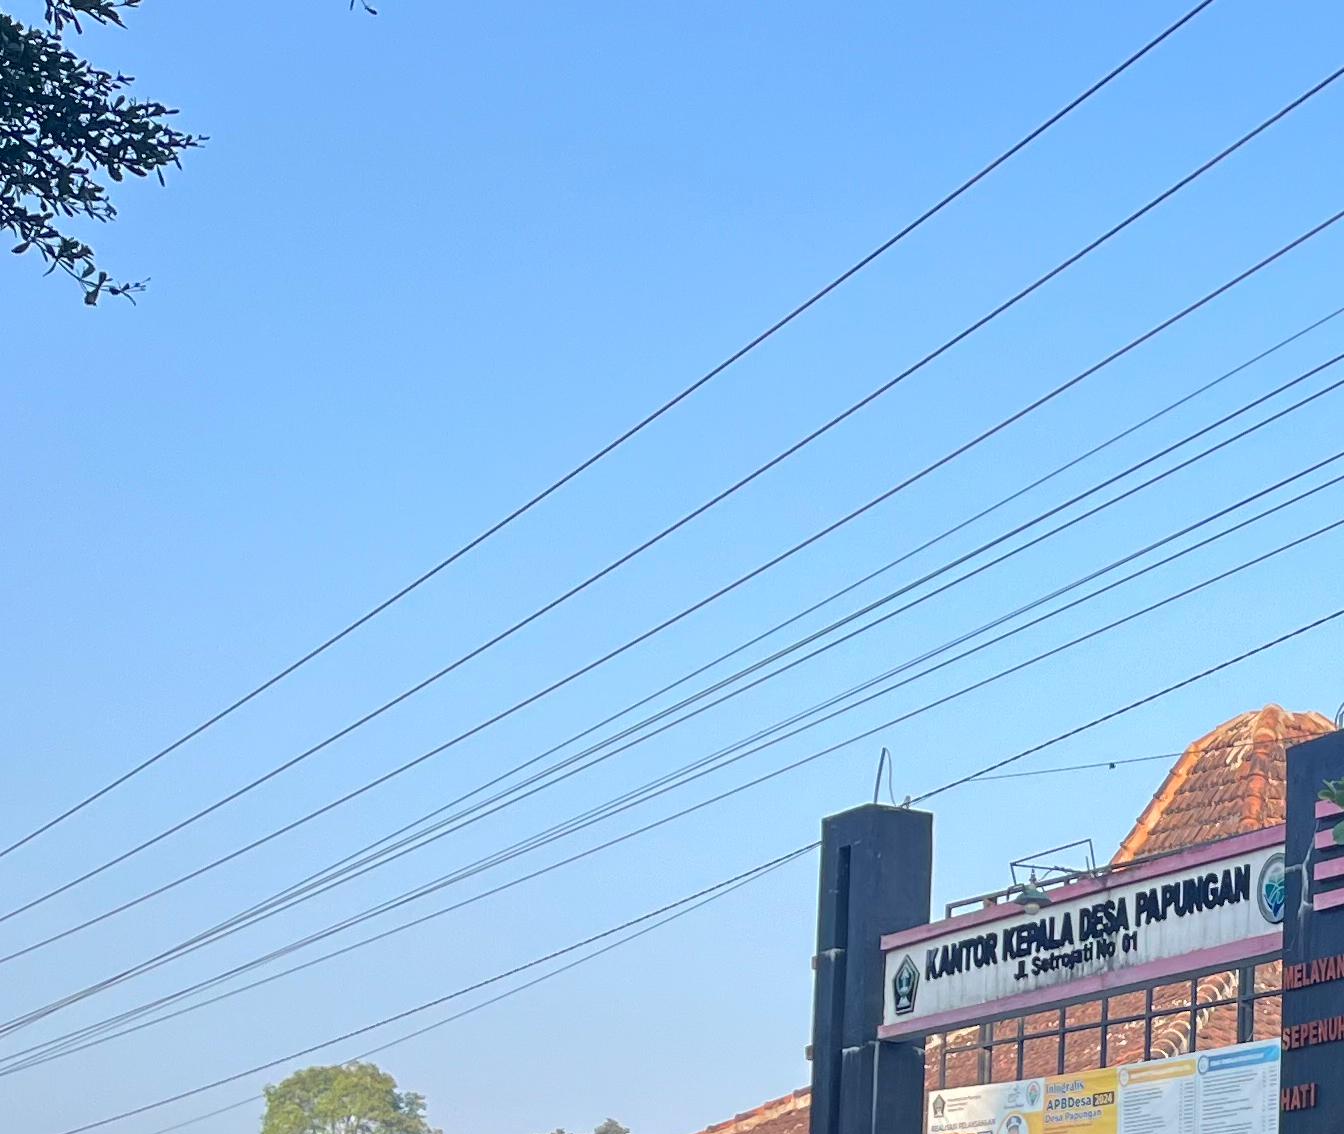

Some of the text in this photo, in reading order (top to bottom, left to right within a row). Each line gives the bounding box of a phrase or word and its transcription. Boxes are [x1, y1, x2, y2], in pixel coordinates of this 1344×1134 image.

[925, 864, 1251, 981] KANTOR KEPALA DESA PAPUNGAN
[1122, 931, 1137, 953] 01
[1047, 1096, 1091, 1111] APBDesa
[1281, 1082, 1316, 1111] HATI
[1045, 1110, 1101, 1124] Desa Papungan
